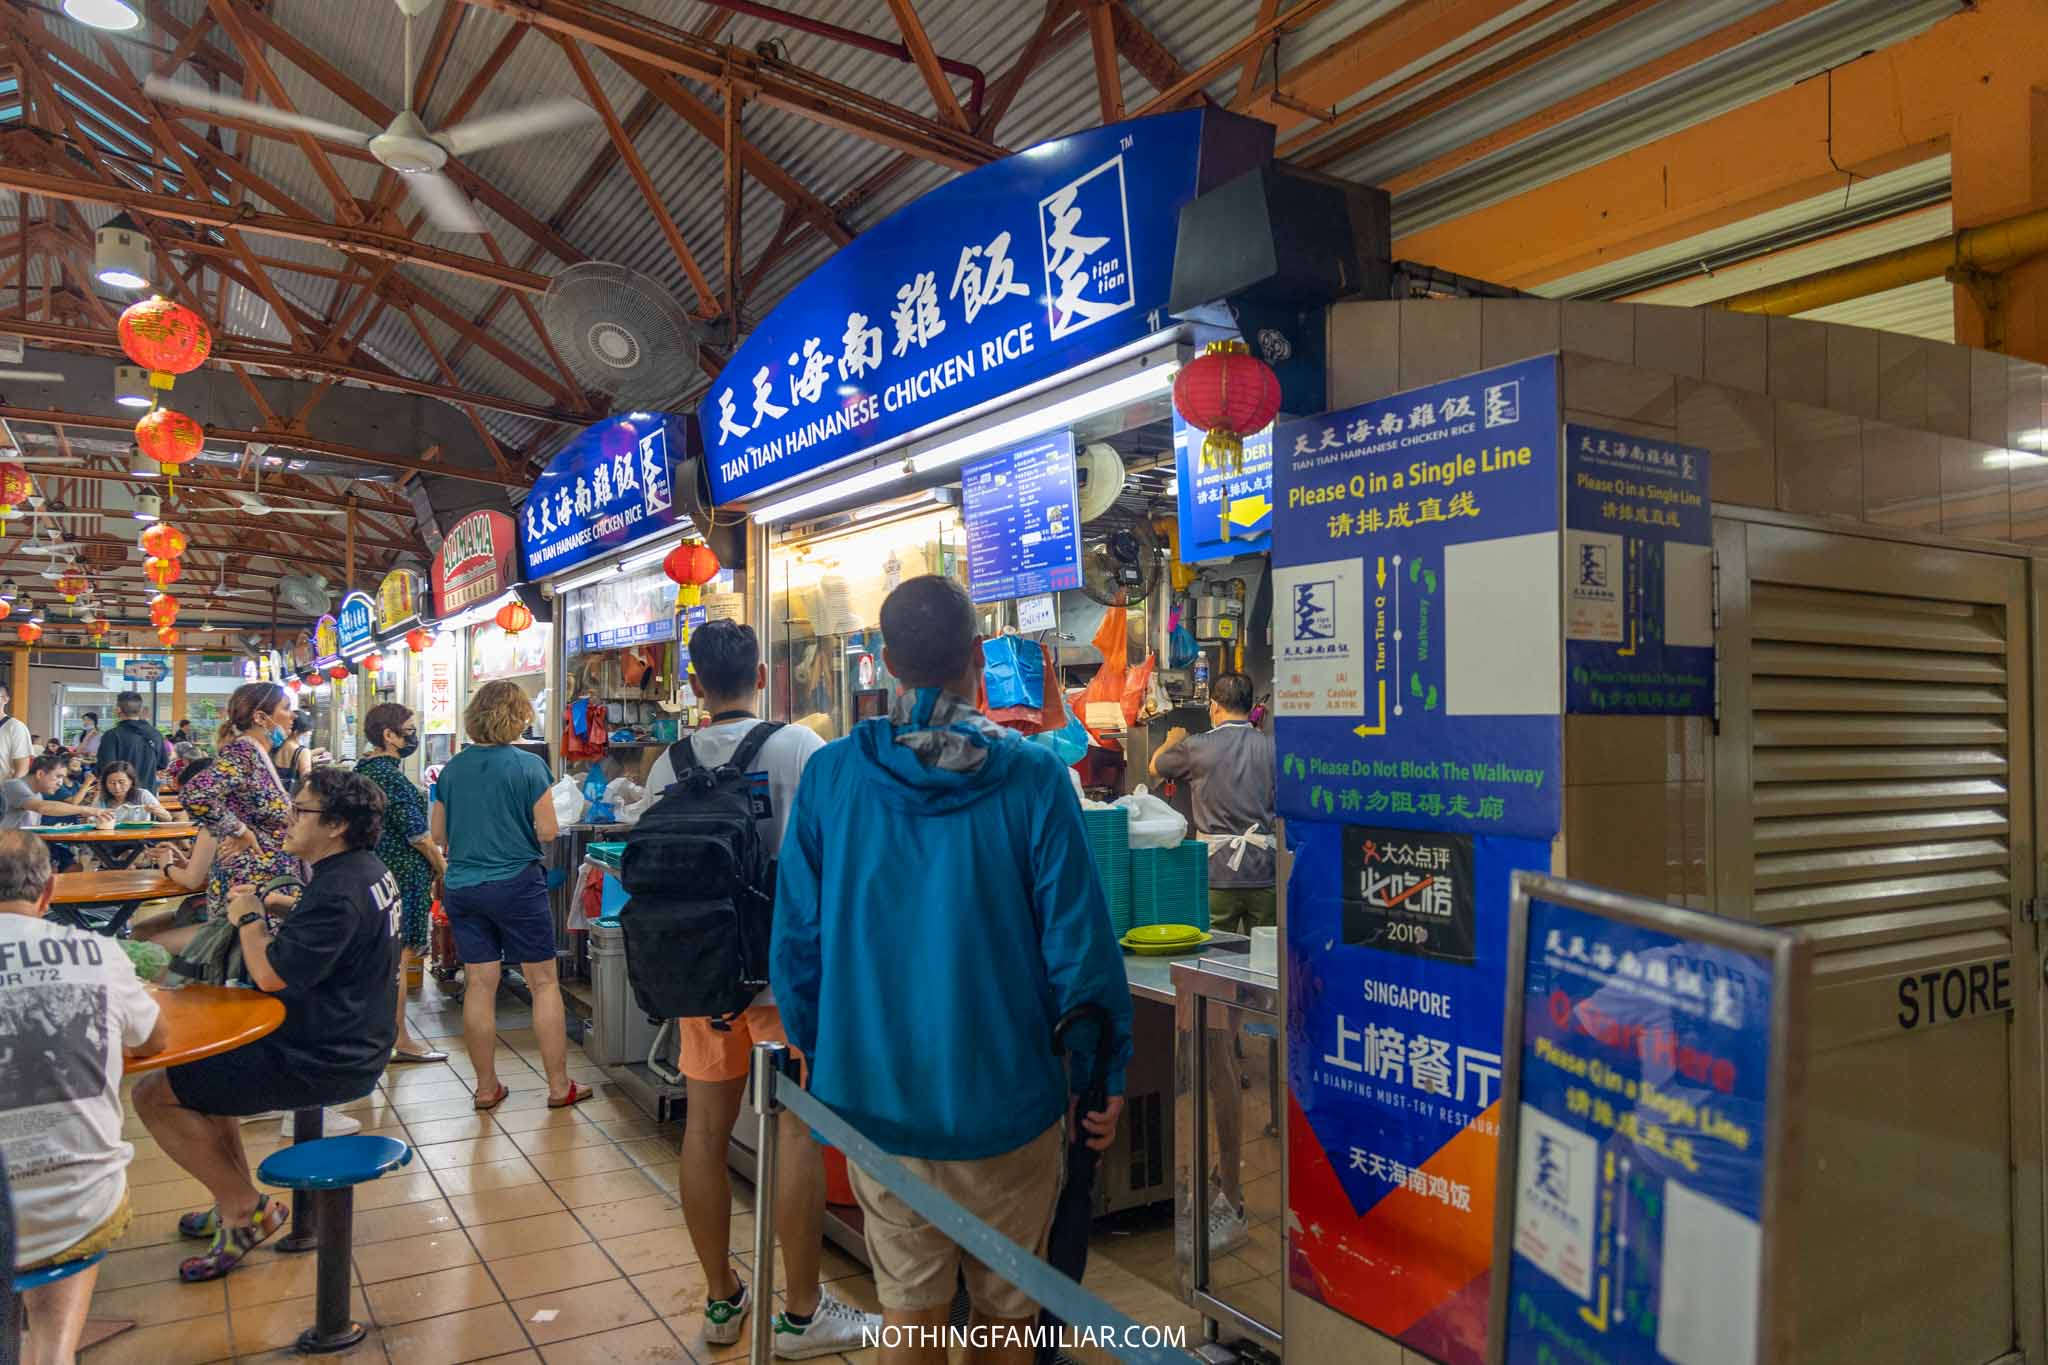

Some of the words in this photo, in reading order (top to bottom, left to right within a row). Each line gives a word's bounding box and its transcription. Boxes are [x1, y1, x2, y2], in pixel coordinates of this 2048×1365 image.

[1120, 134, 1134, 152] TM
[1092, 256, 1119, 280] tian
[1098, 271, 1125, 295] tian
[720, 452, 748, 484] TIAN
[749, 439, 783, 473] TIAN
[785, 398, 880, 454] HAINANESE
[883, 350, 975, 413] CHICKEN
[982, 322, 1034, 372] RICE
[1292, 459, 1314, 472] TIAN
[1316, 453, 1339, 468] TIAN
[1341, 440, 1398, 460] HAINANESE
[1400, 429, 1449, 448] CHICKEN
[1451, 422, 1476, 436] RICE
[1288, 483, 1346, 509] Please
[1350, 475, 1365, 498] Q
[1369, 472, 1388, 494] in
[1392, 473, 1405, 489] a
[1409, 453, 1476, 486] Single
[1481, 446, 1532, 473] Line
[1576, 472, 1614, 493] Please
[1615, 479, 1625, 496] Q
[1625, 480, 1638, 497] in
[1638, 486, 1645, 498] a
[1647, 485, 1679, 505] Single
[1680, 488, 1702, 506] Line
[528, 552, 542, 567] TIAN
[543, 545, 557, 564] TIAN
[556, 527, 593, 556] HAINANESE
[593, 512, 624, 540] CHICKEN
[625, 504, 643, 527] RICE
[1327, 490, 1480, 538] 请排成直线
[1375, 596, 1386, 608] Q
[1375, 610, 1385, 641] Tian
[1418, 598, 1430, 662] Walkway
[1375, 642, 1385, 672] Tian
[1310, 758, 1349, 777] Please
[1352, 759, 1370, 777] Do
[1372, 760, 1398, 778] Not
[1401, 760, 1440, 780] Block
[1441, 762, 1470, 782] The
[1472, 763, 1545, 790] Walkway
[1338, 788, 1505, 821] 请勿阻碍走廊
[1381, 841, 1451, 871] 大众点评
[1361, 866, 1453, 917] 必吃榜
[0, 937, 103, 971] FLOYD
[1363, 978, 1451, 1019] SINGAPORE
[1897, 959, 2012, 1030] STORE
[1323, 1013, 1502, 1109] 上榜餐厅
[1549, 989, 1571, 1031] Q
[1576, 998, 1648, 1057] Start
[1653, 1025, 1736, 1094] Here
[1313, 1070, 1319, 1083] A
[1322, 1072, 1373, 1099] DIANPING
[1376, 1090, 1434, 1119] MUST-TRY
[1535, 1036, 1587, 1078] Please
[1639, 1081, 1697, 1127] Single
[1700, 1106, 1749, 1150] Line
[1349, 1146, 1473, 1213] 天天海南鸡饭
